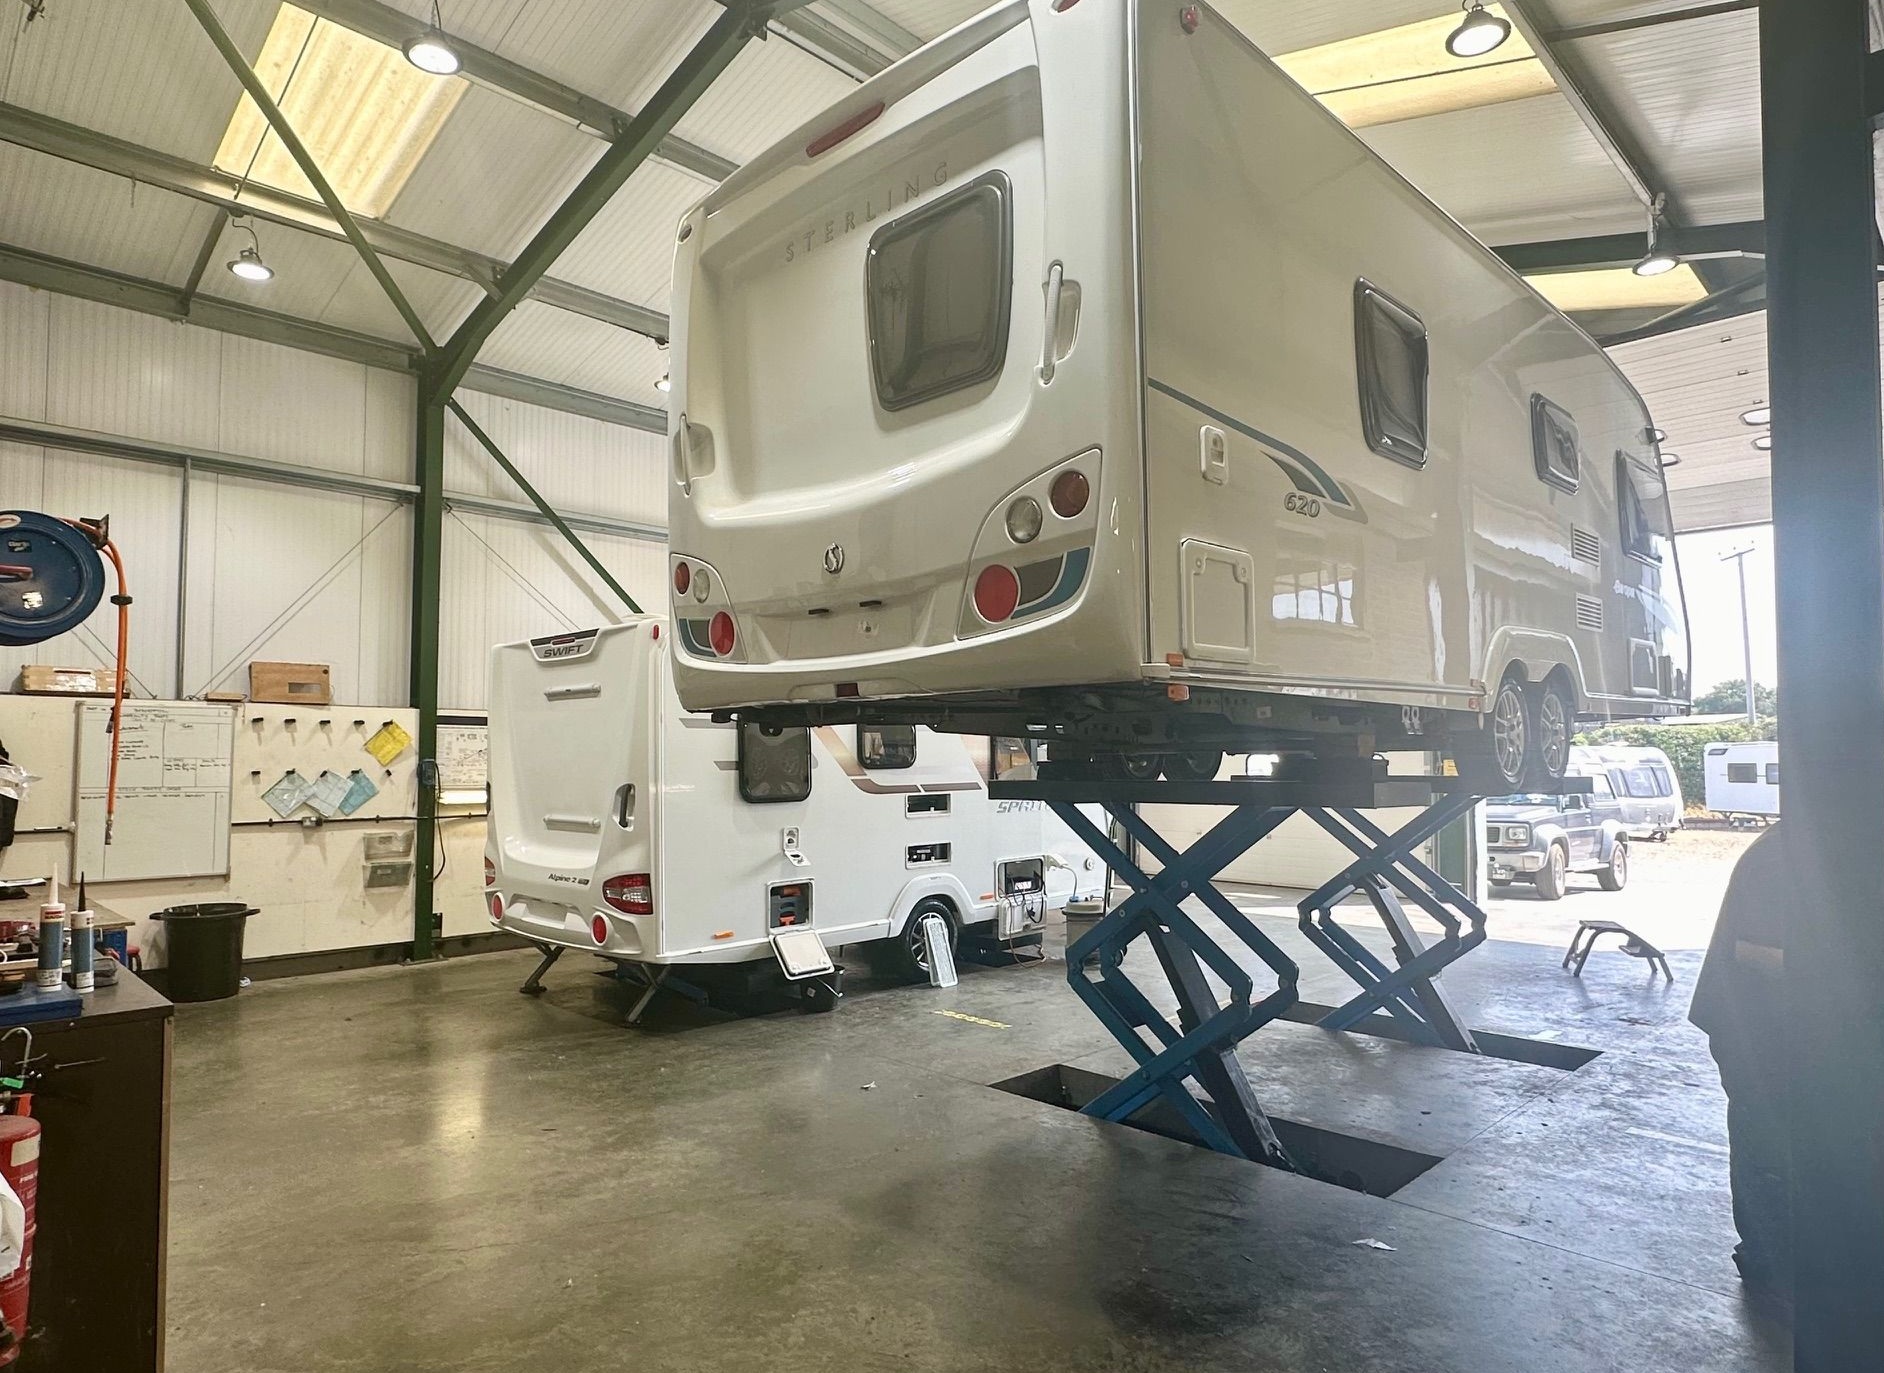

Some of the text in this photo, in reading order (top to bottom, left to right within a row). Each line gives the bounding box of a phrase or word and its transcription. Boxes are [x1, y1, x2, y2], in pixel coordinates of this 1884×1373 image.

[785, 162, 948, 263] STERLING
[1284, 492, 1321, 518] 620
[543, 644, 584, 658] SWIFT
[548, 873, 571, 882] Alpine
